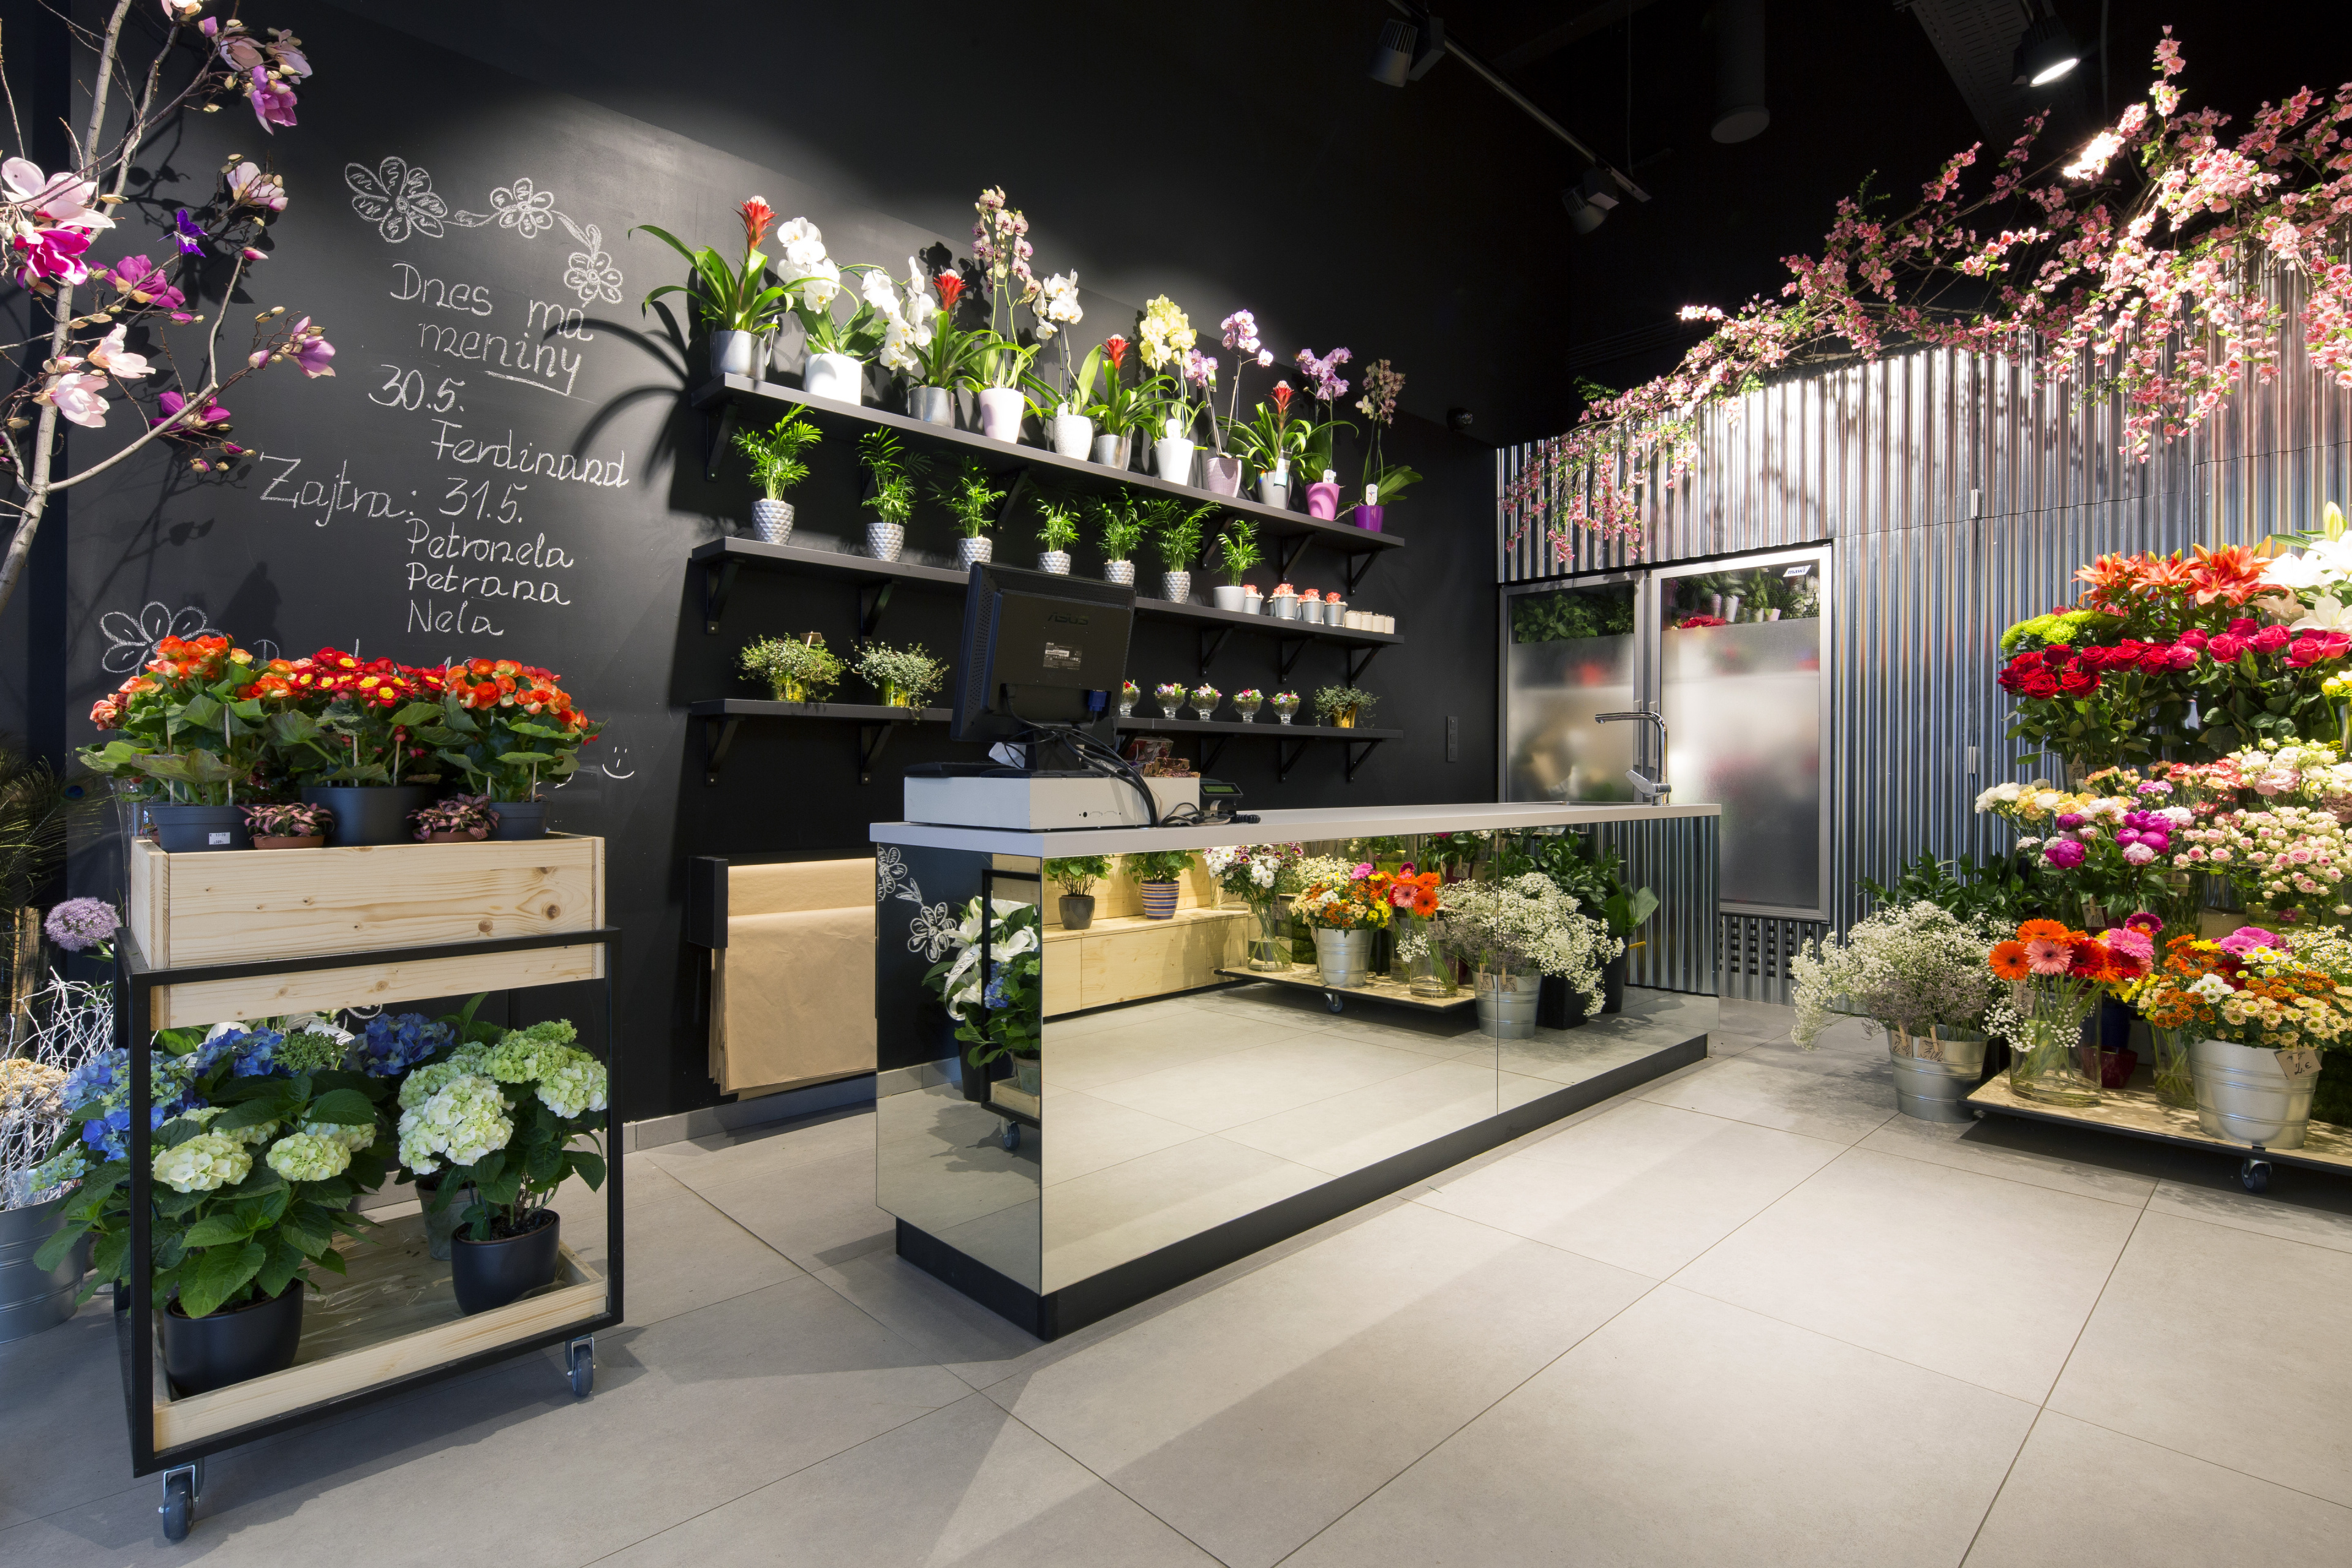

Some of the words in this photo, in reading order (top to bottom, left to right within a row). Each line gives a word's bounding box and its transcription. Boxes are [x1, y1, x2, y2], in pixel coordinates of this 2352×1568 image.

[390, 263, 492, 316] Dnes
[418, 323, 581, 396] meniny
[368, 364, 466, 412] 30.5.
[431, 419, 629, 488] Ferdinand
[260, 452, 417, 527] Zajtra:
[439, 478, 527, 524] 31.5.
[405, 518, 574, 568] Petronela
[405, 562, 570, 605] Petrana
[408, 600, 504, 636] Nela
[1047, 612, 1088, 625] ASUS
